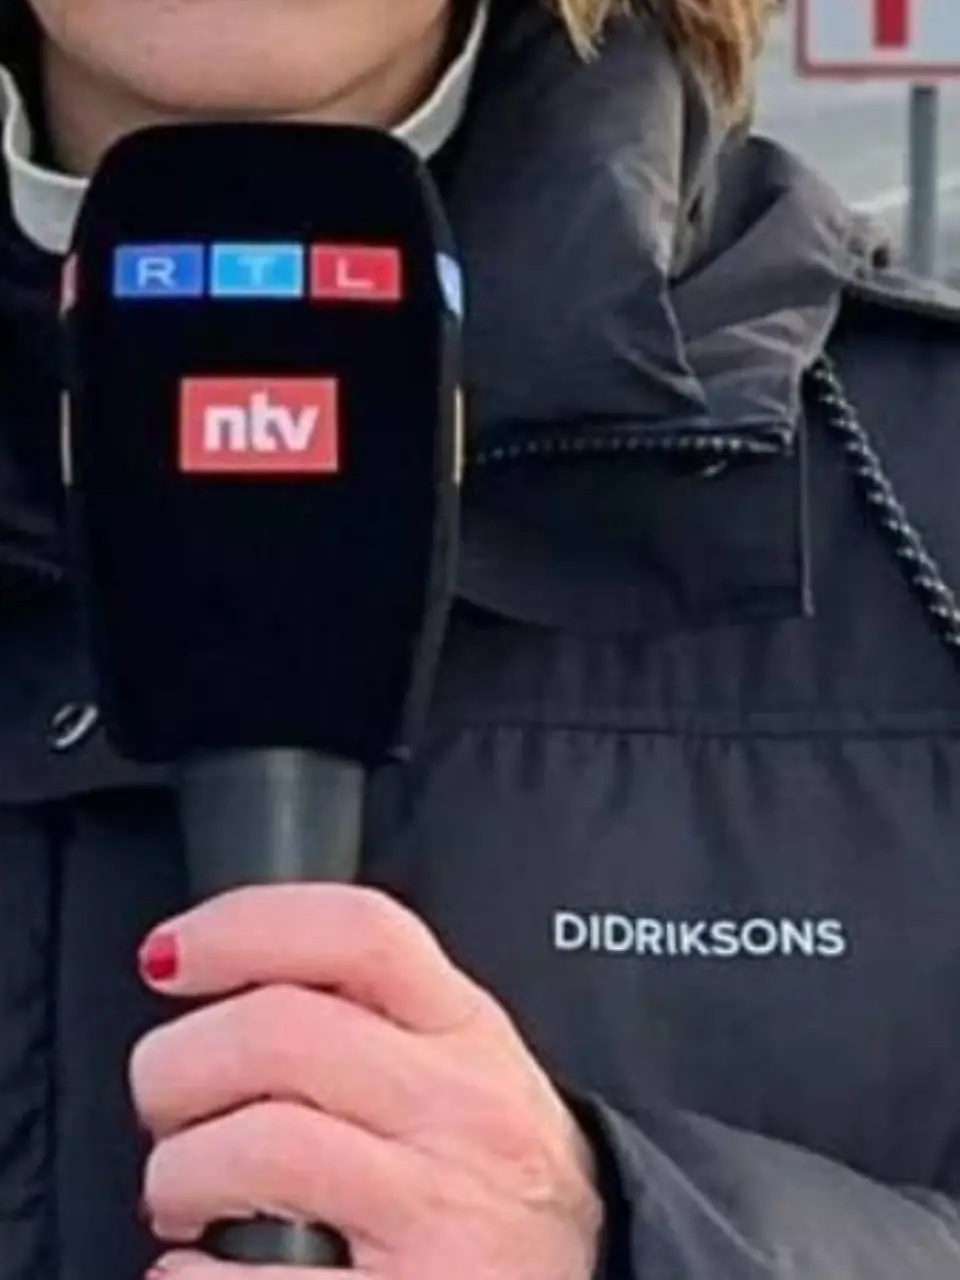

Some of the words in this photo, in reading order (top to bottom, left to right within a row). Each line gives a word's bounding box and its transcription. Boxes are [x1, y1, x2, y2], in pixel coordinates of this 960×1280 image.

[132, 253, 378, 290] RTL
[201, 387, 321, 454] ntv
[553, 911, 846, 957] DIDRIKSONS
